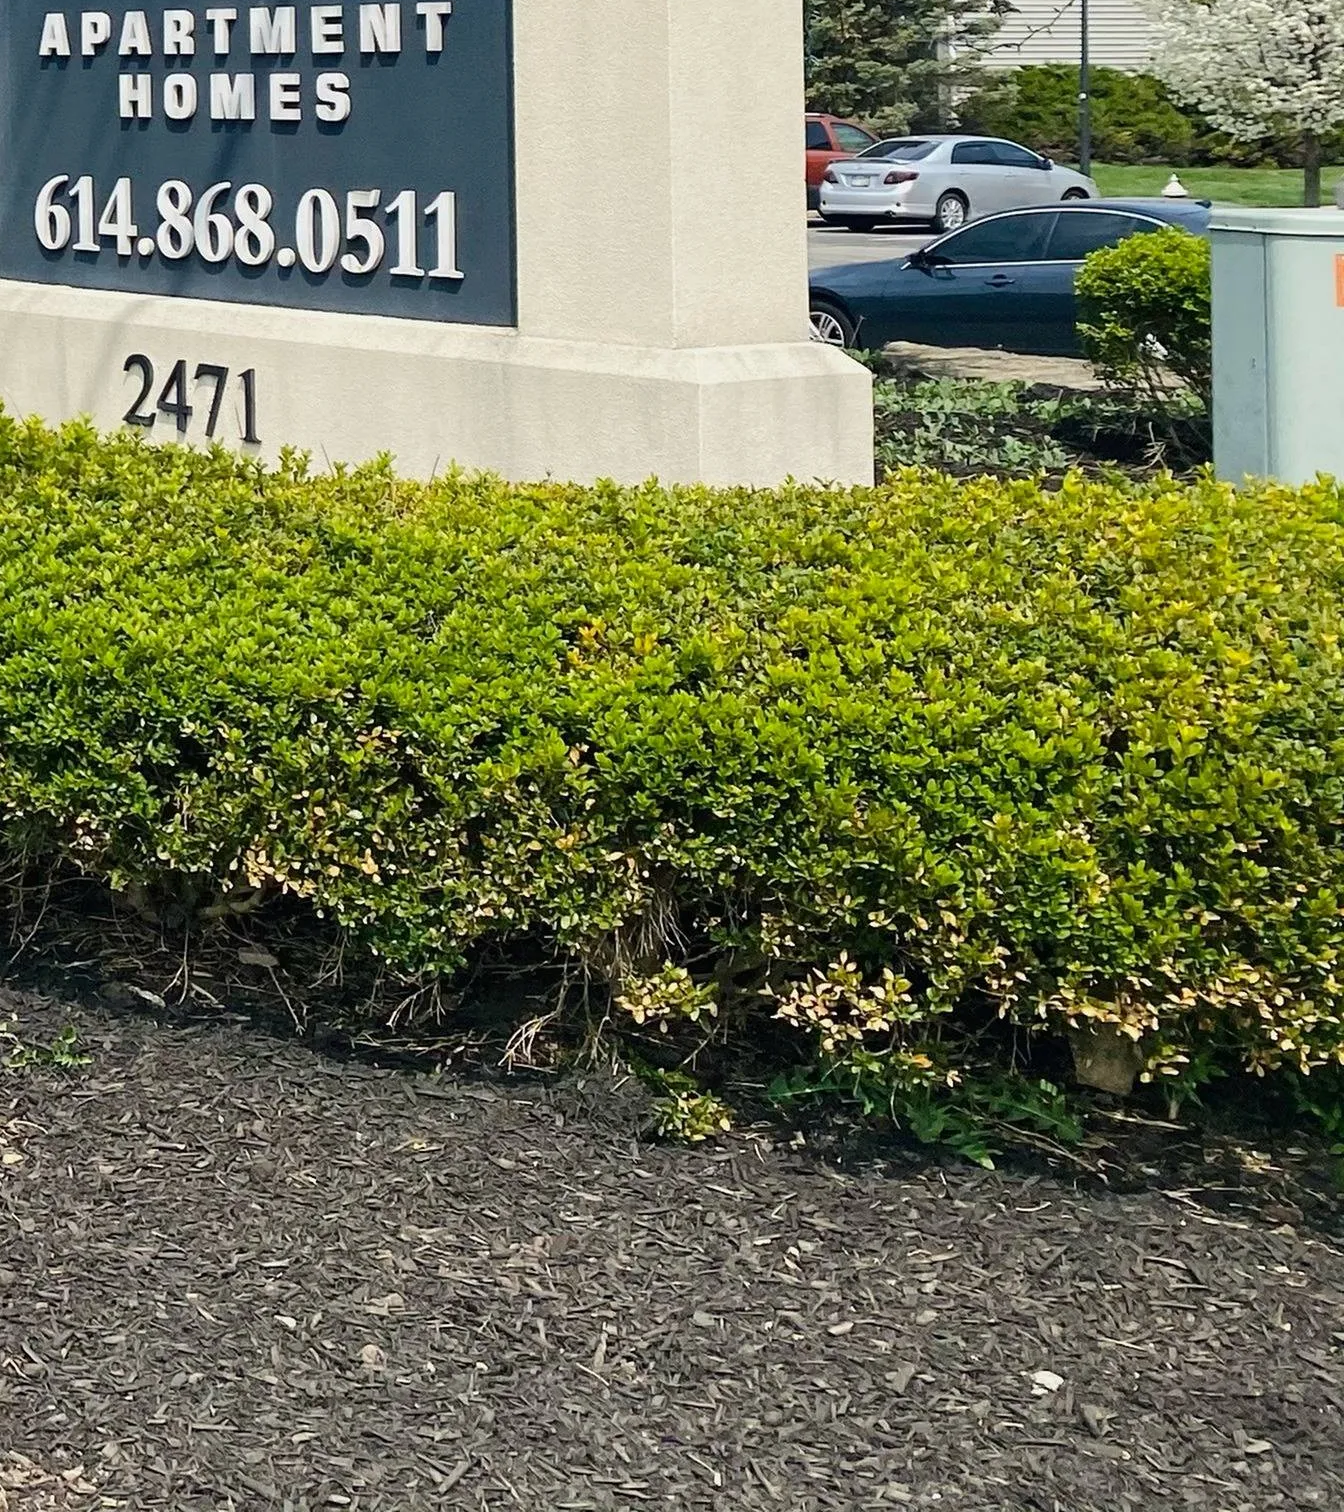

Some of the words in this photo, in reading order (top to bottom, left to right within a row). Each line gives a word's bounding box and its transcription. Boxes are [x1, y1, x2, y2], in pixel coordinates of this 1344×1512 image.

[38, 1, 452, 57] APARTMENT
[118, 72, 352, 121] HOMES
[34, 175, 464, 280] 614.868.0511
[124, 355, 261, 443] 2471
